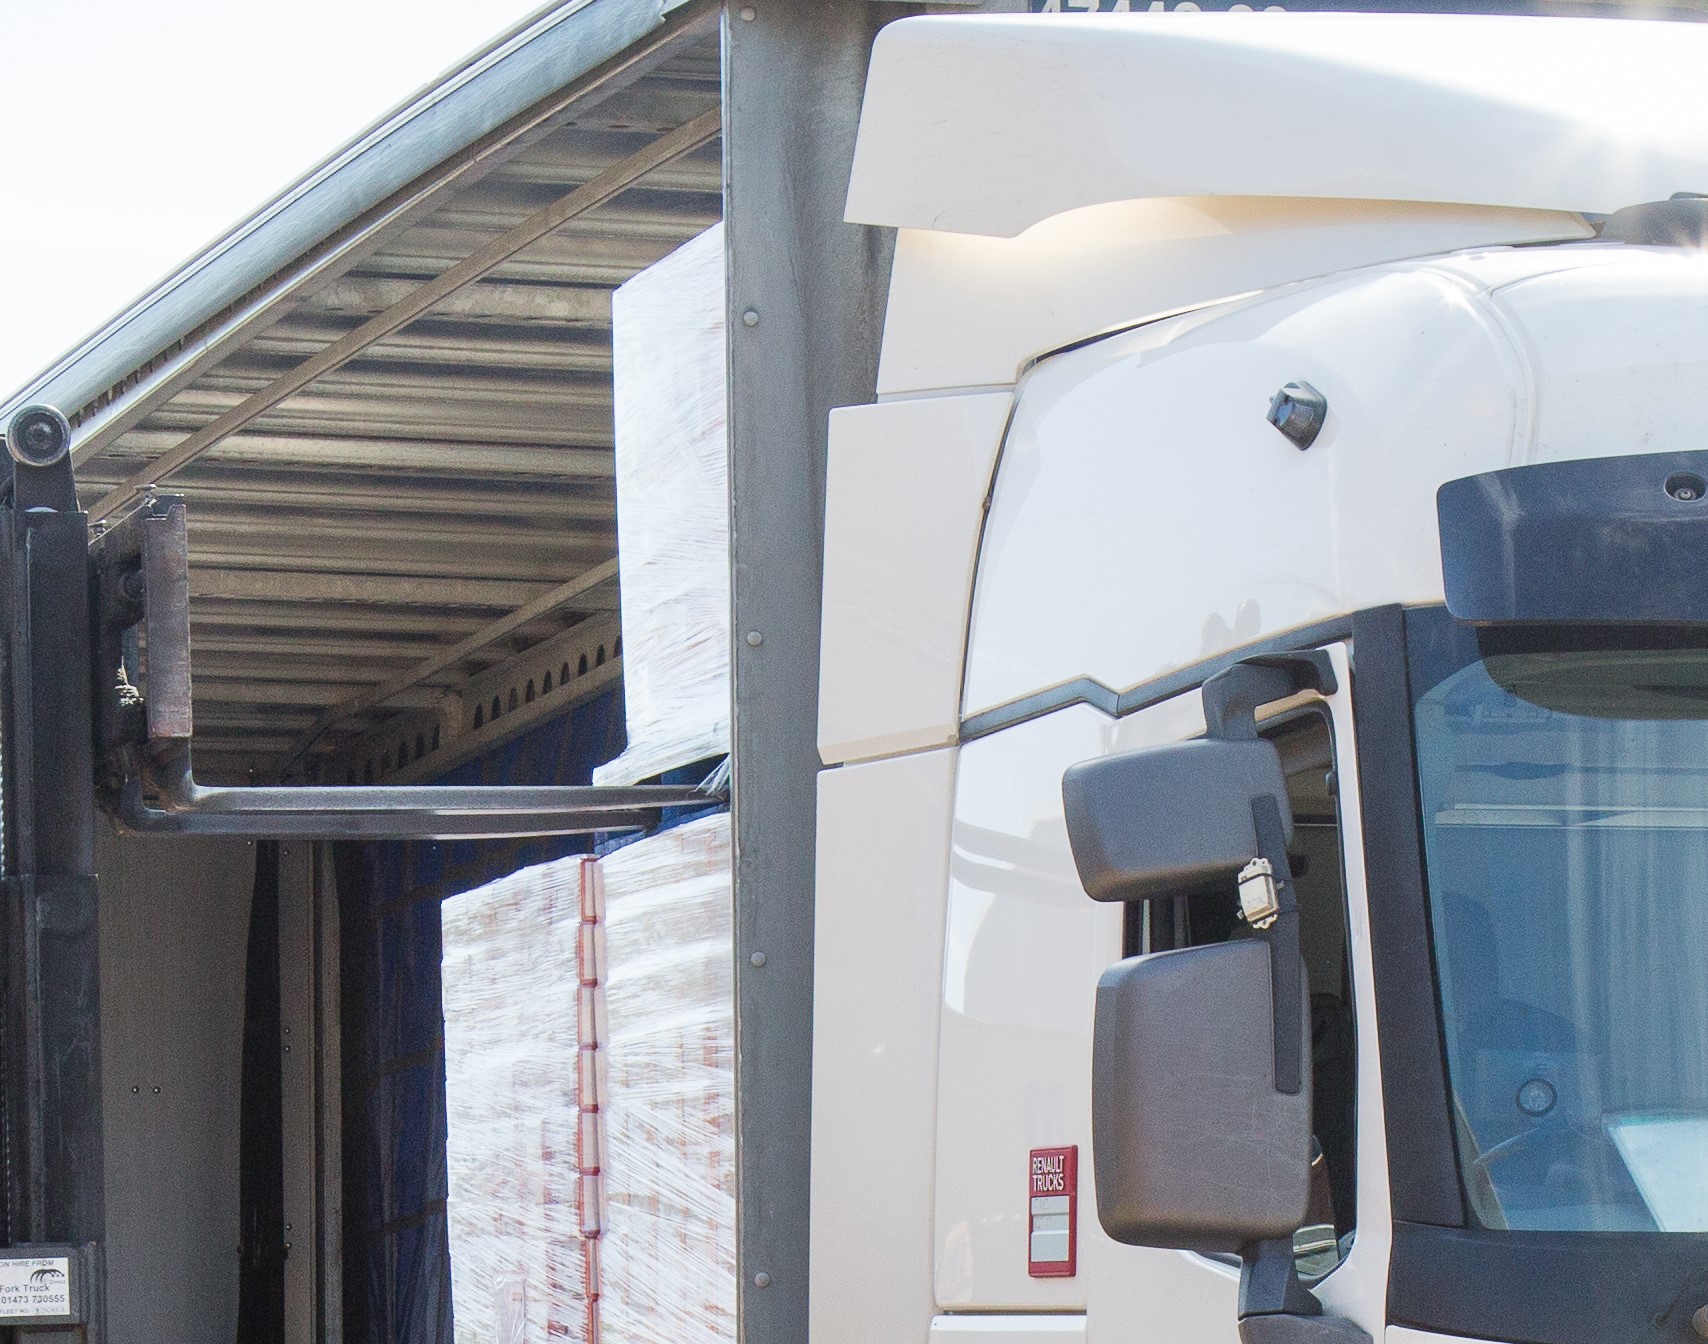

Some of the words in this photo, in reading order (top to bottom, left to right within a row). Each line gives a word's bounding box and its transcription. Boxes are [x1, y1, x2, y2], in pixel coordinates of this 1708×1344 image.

[1032, 1155, 1064, 1174] RENAULT
[1032, 1173, 1064, 1191] TRUCKS
[0, 1284, 20, 1293] Fork
[23, 1283, 50, 1292] Truck
[1, 1295, 29, 1304] 01473
[32, 1294, 65, 1303] 730555
